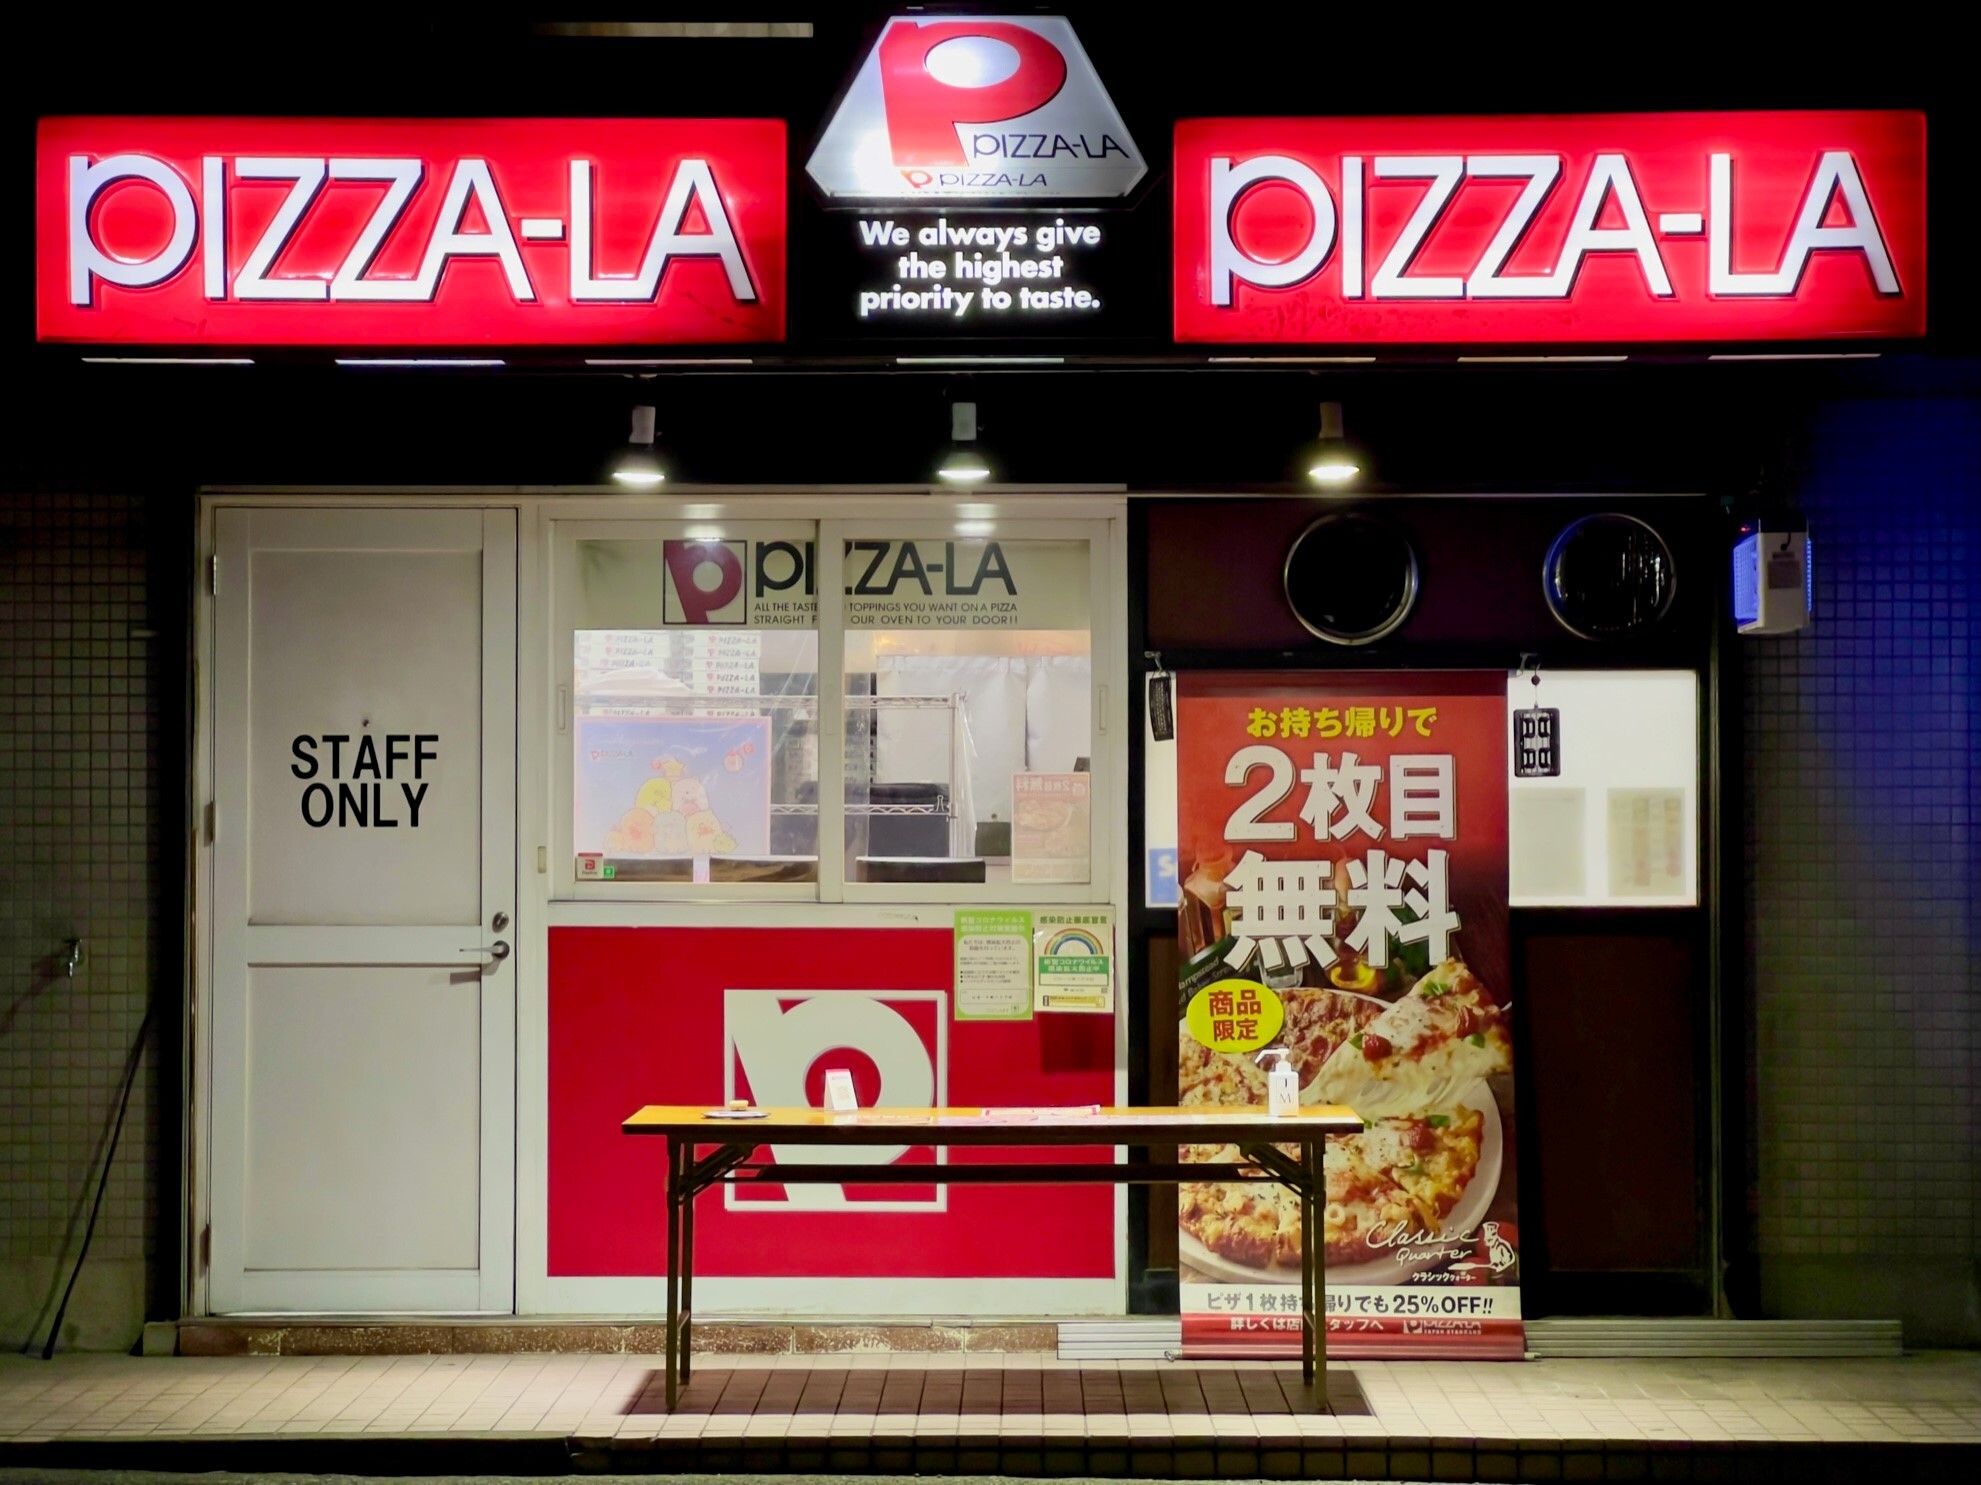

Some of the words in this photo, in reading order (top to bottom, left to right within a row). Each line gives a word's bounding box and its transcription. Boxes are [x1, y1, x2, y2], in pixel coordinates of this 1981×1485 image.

[859, 220, 911, 246] We
[918, 218, 1028, 252] always
[1036, 218, 1102, 251] give
[898, 252, 947, 279] the
[955, 252, 1065, 285] highest
[860, 284, 975, 317] priority
[981, 287, 1013, 311] to
[1019, 287, 1102, 311] taste.
[753, 614, 805, 625] STRAIGHT
[850, 614, 875, 625] OUR
[880, 614, 913, 625] OVEN
[917, 614, 931, 625] TO
[936, 614, 967, 625] YOUR
[754, 602, 770, 612] ALL
[772, 602, 790, 612] THE
[849, 602, 901, 613] TOPPINGS
[903, 602, 926, 613] YOU
[928, 602, 958, 613] WANT
[961, 602, 978, 613] ON
[980, 602, 988, 613] A
[990, 602, 1018, 613] PIZZA
[1246, 706, 1438, 739] お持ち帰りで
[291, 734, 439, 780] STAFF
[301, 782, 429, 828] ONLY
[1223, 744, 1457, 842] 2枚目
[1222, 849, 1462, 973] 無料
[1208, 989, 1262, 1017] 商品
[1213, 1018, 1259, 1042] 限定
[1366, 1219, 1480, 1249] Classic
[1396, 1246, 1473, 1267] Quarter
